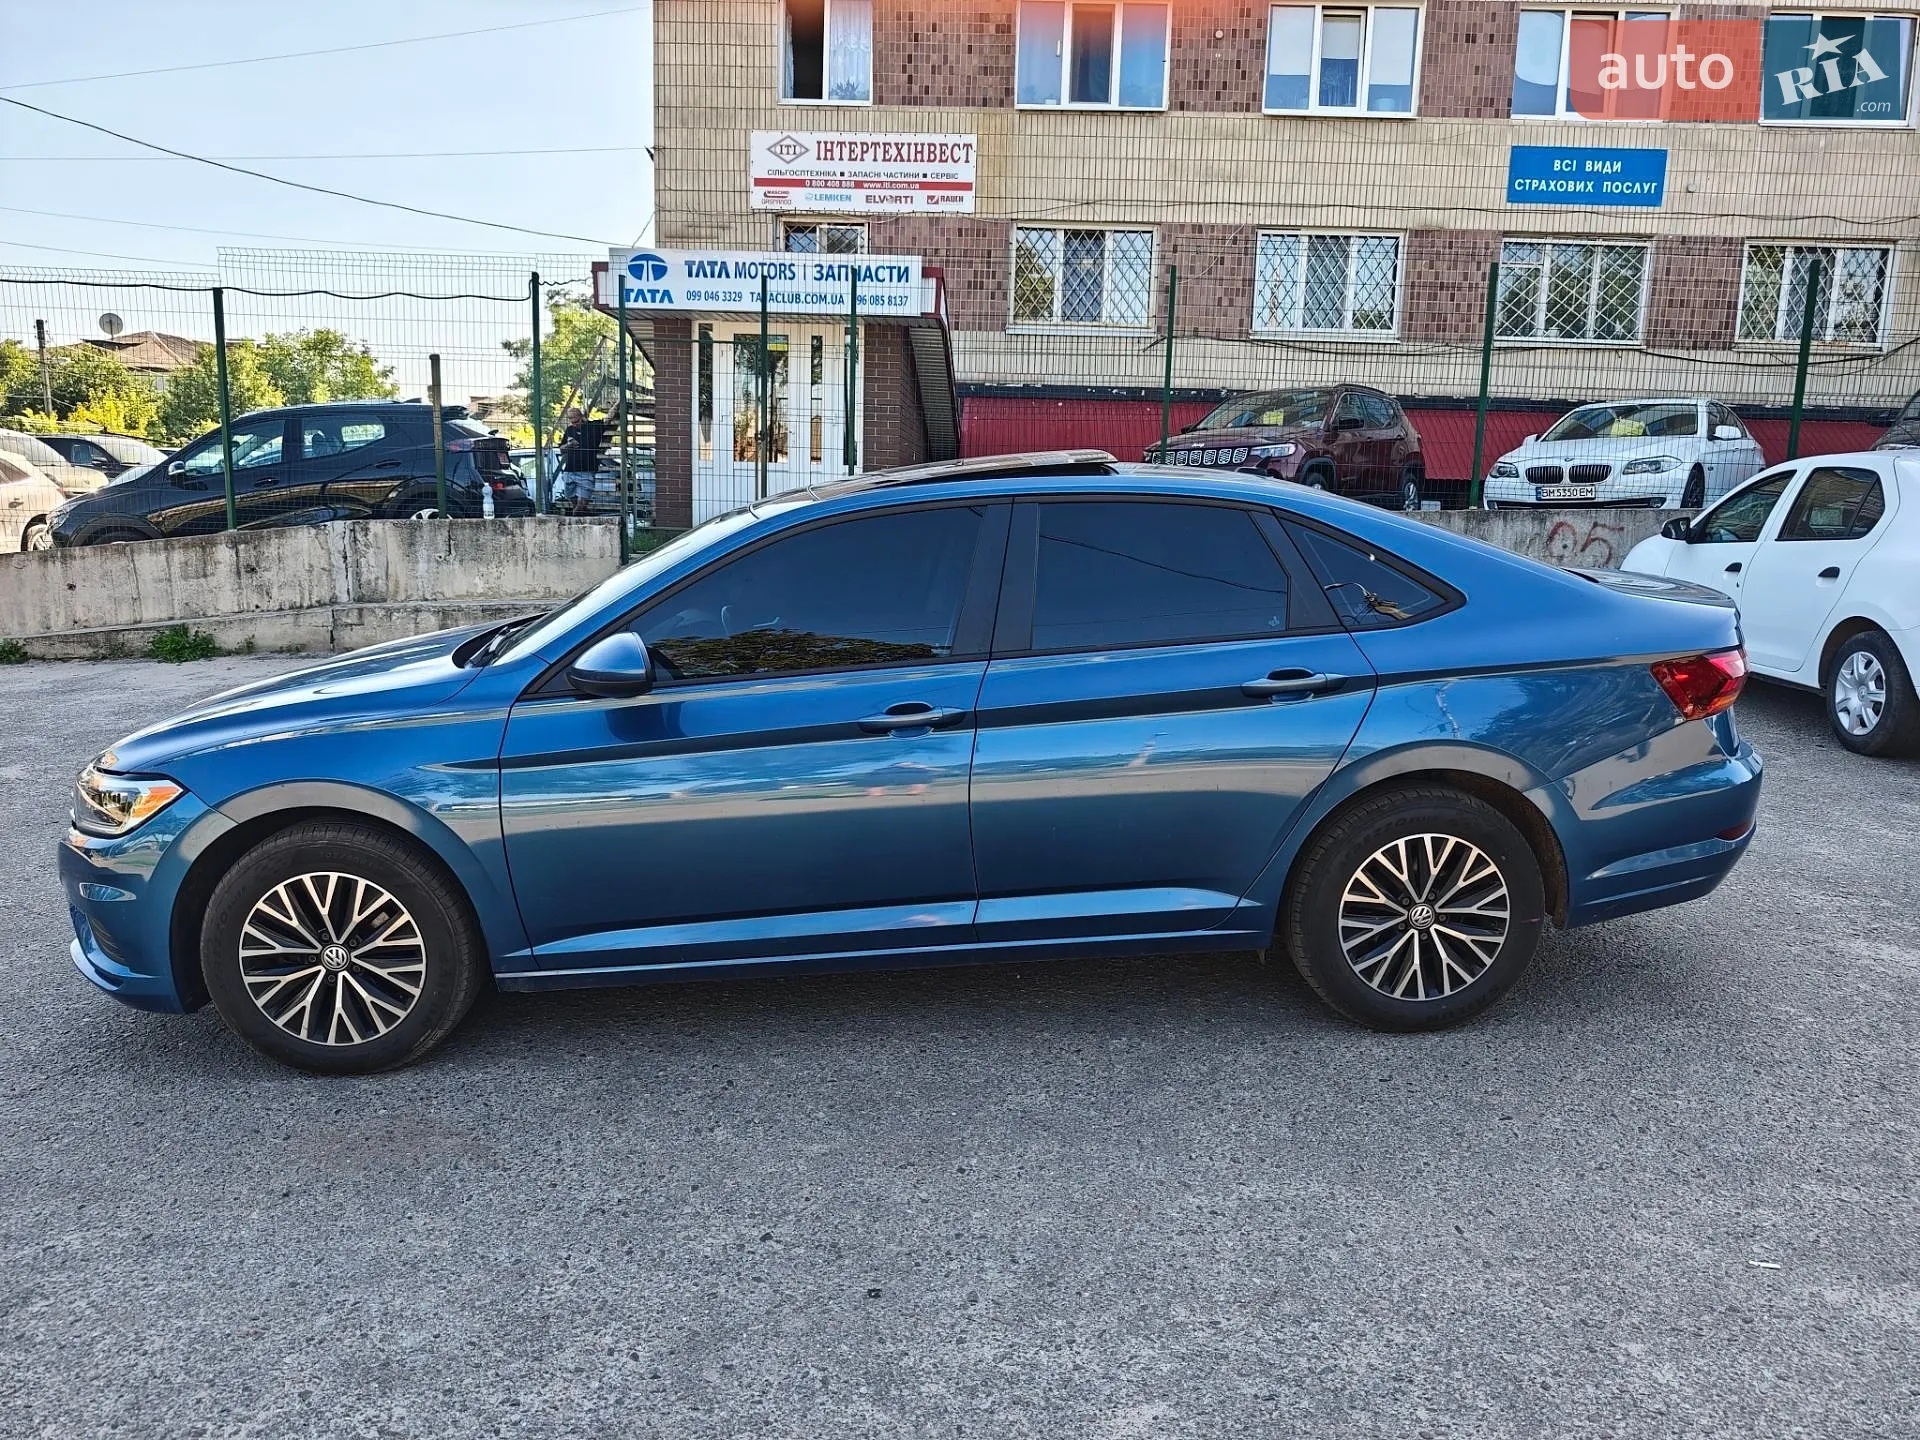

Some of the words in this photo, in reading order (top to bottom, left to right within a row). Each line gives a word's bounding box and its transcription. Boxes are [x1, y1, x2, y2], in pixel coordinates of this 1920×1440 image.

[815, 140, 973, 164] ІНТЕРТЕХІНВЕСТ
[1553, 160, 1577, 172] ВСІ
[1585, 160, 1622, 174] ВИДИ
[767, 169, 837, 177] СІЛЬГОСПТЕХНІКА
[847, 171, 882, 179] ЗАПАСНІ
[883, 171, 920, 179] ЧАСТИНИ
[930, 172, 959, 180] СЕРВІС
[1514, 178, 1594, 193] СТРАХОВИХ
[1602, 181, 1658, 194] ПОСЛУГ
[814, 193, 852, 202] LEMKEN
[684, 260, 731, 279] TATA
[734, 261, 796, 281] MOTORS
[624, 288, 674, 304] TATA
[686, 290, 701, 302] 099
[704, 290, 720, 302] 046
[721, 291, 743, 303] 3329
[749, 291, 845, 306] TAACLUB.COM.UA
[869, 295, 885, 307] 085
[887, 296, 909, 307] 8137
